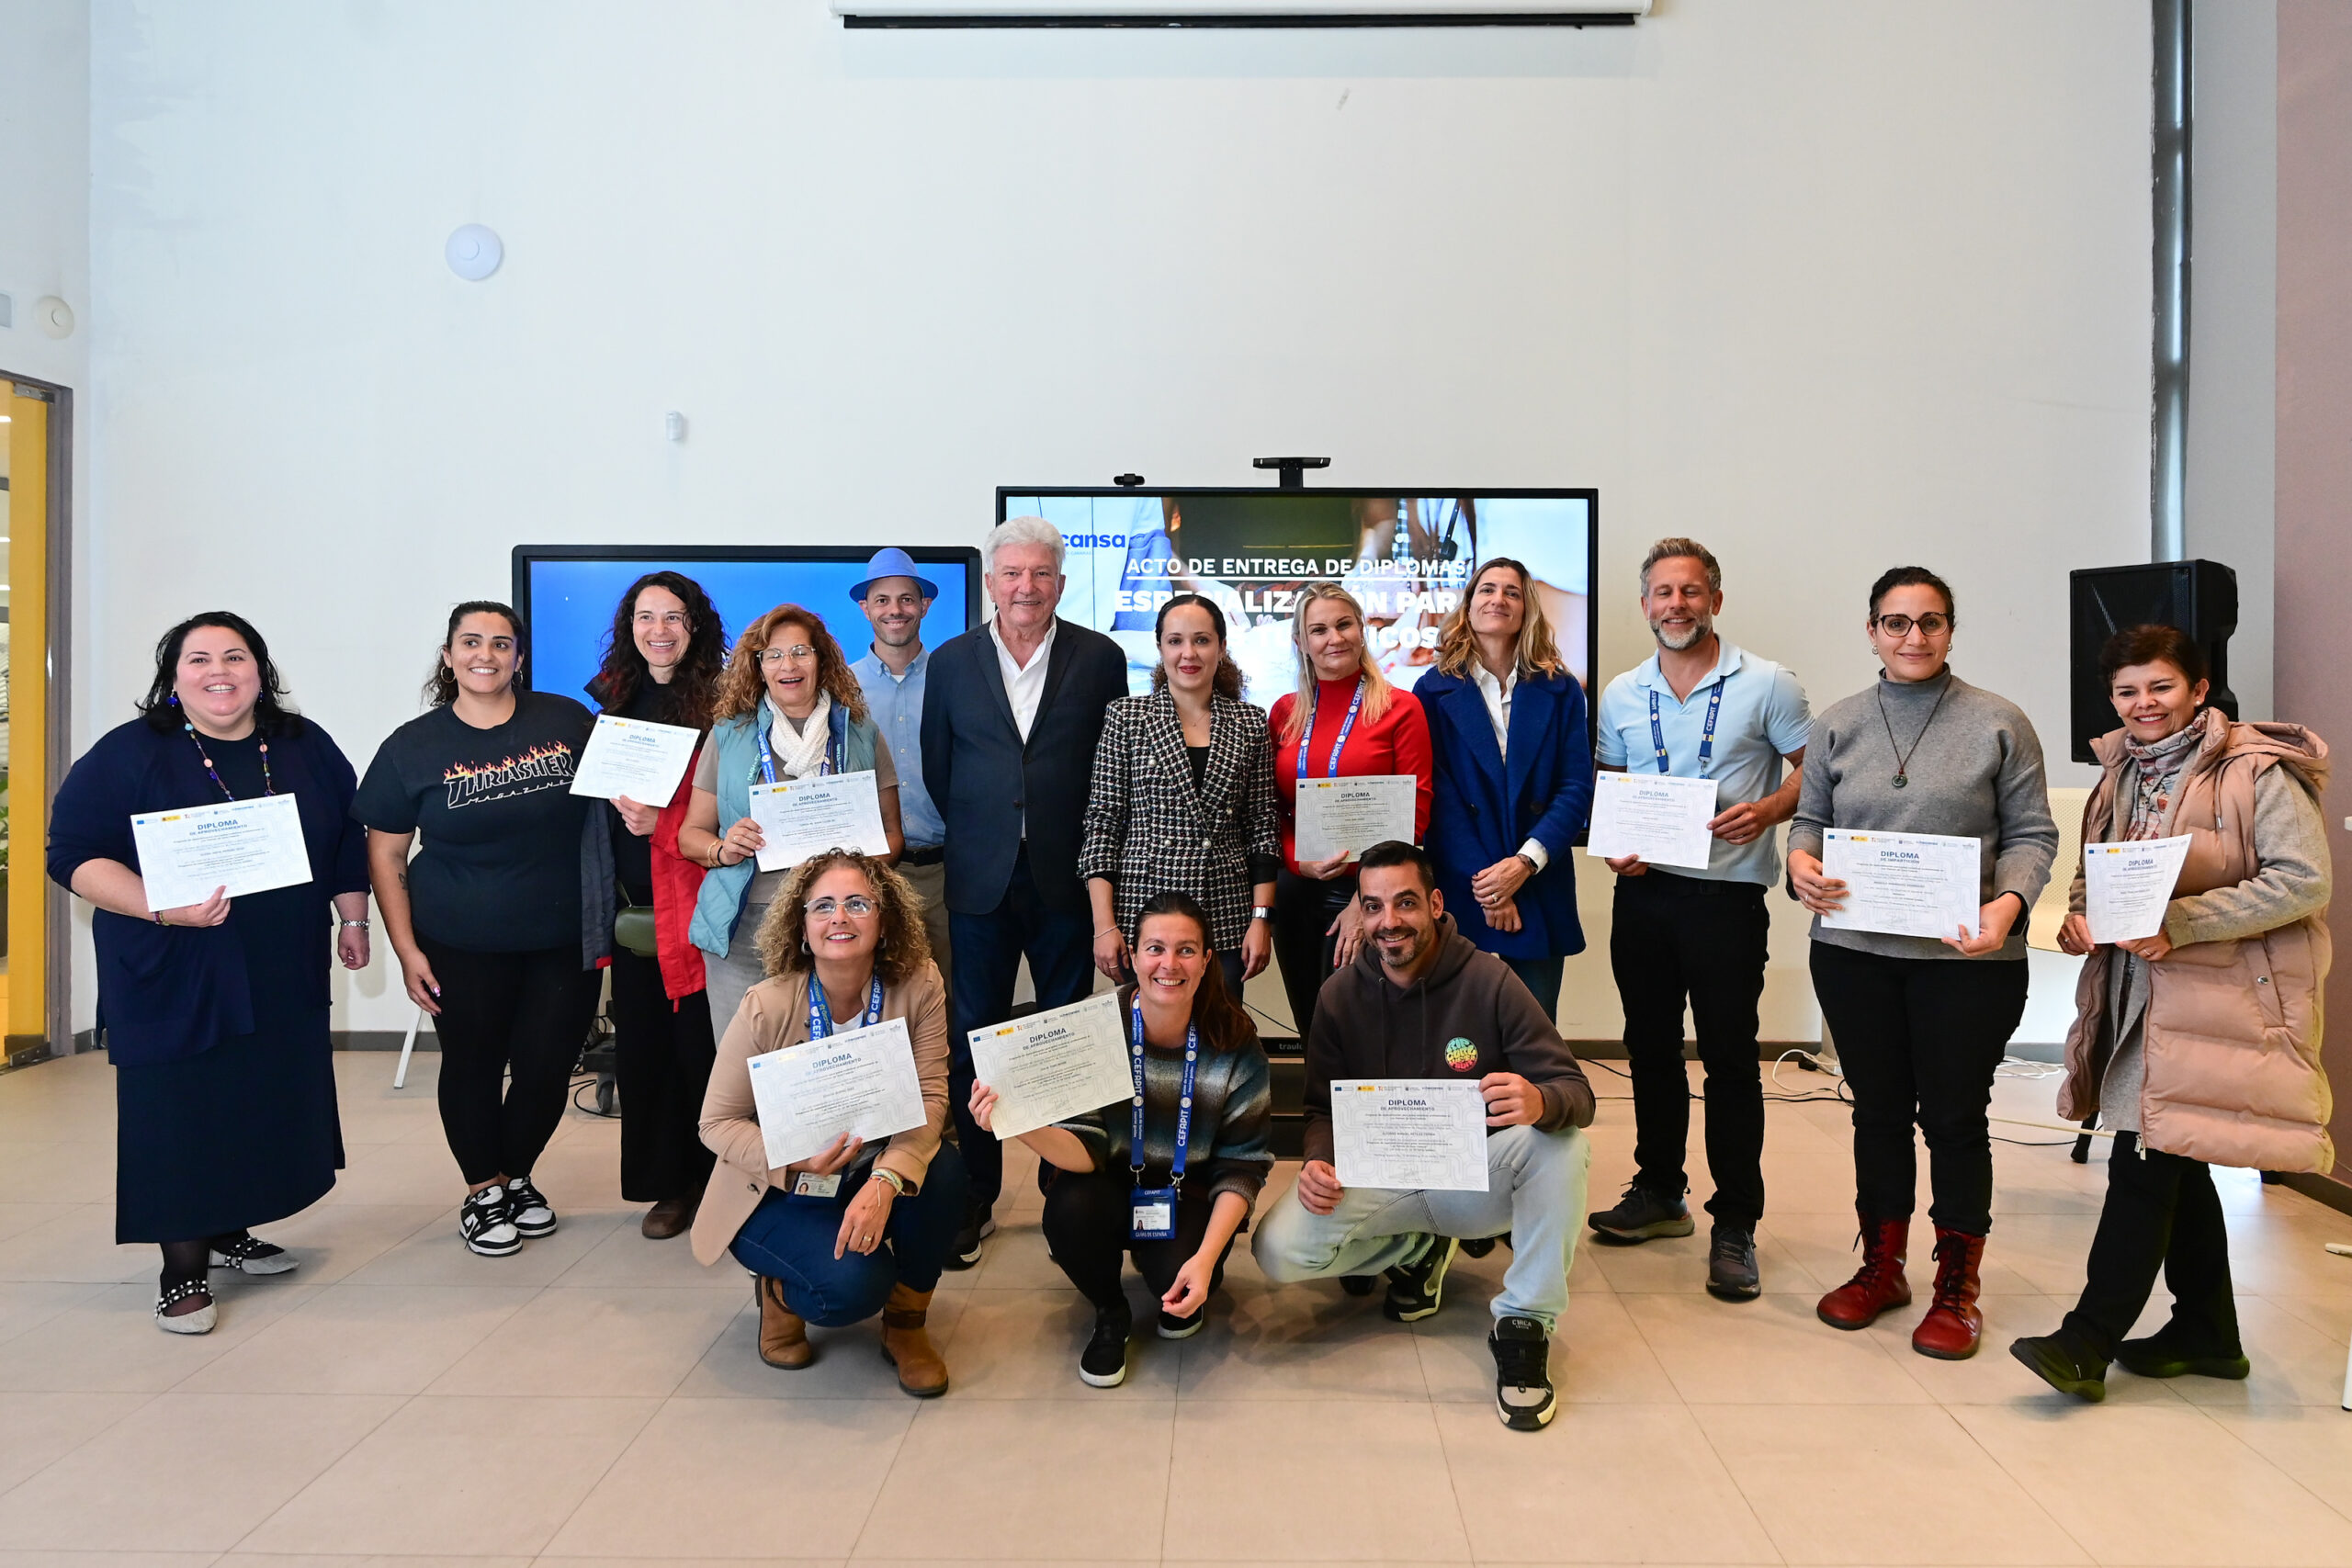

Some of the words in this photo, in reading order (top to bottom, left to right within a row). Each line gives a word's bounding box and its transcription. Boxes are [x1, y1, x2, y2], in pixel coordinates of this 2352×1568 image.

[1126, 558, 1181, 574] ACTO
[1189, 558, 1216, 574] DE
[1223, 558, 1318, 575] ENTREGA
[1326, 558, 1352, 574] DE
[1360, 559, 1465, 575] DIPLOMAS
[1396, 592, 1458, 614] PAR
[443, 751, 576, 807] THRASHER
[468, 779, 564, 803] MAGAZINE
[798, 792, 831, 802] DIPLOMA
[198, 818, 238, 830] DIPLOMA
[1881, 851, 1919, 859] DIPLOMA
[1029, 1028, 1067, 1043] DIPLOMA
[812, 1053, 853, 1068] DIPLOMA
[1134, 1057, 1142, 1094] CEFAPIT
[1178, 1111, 1189, 1146] CEFAPIT
